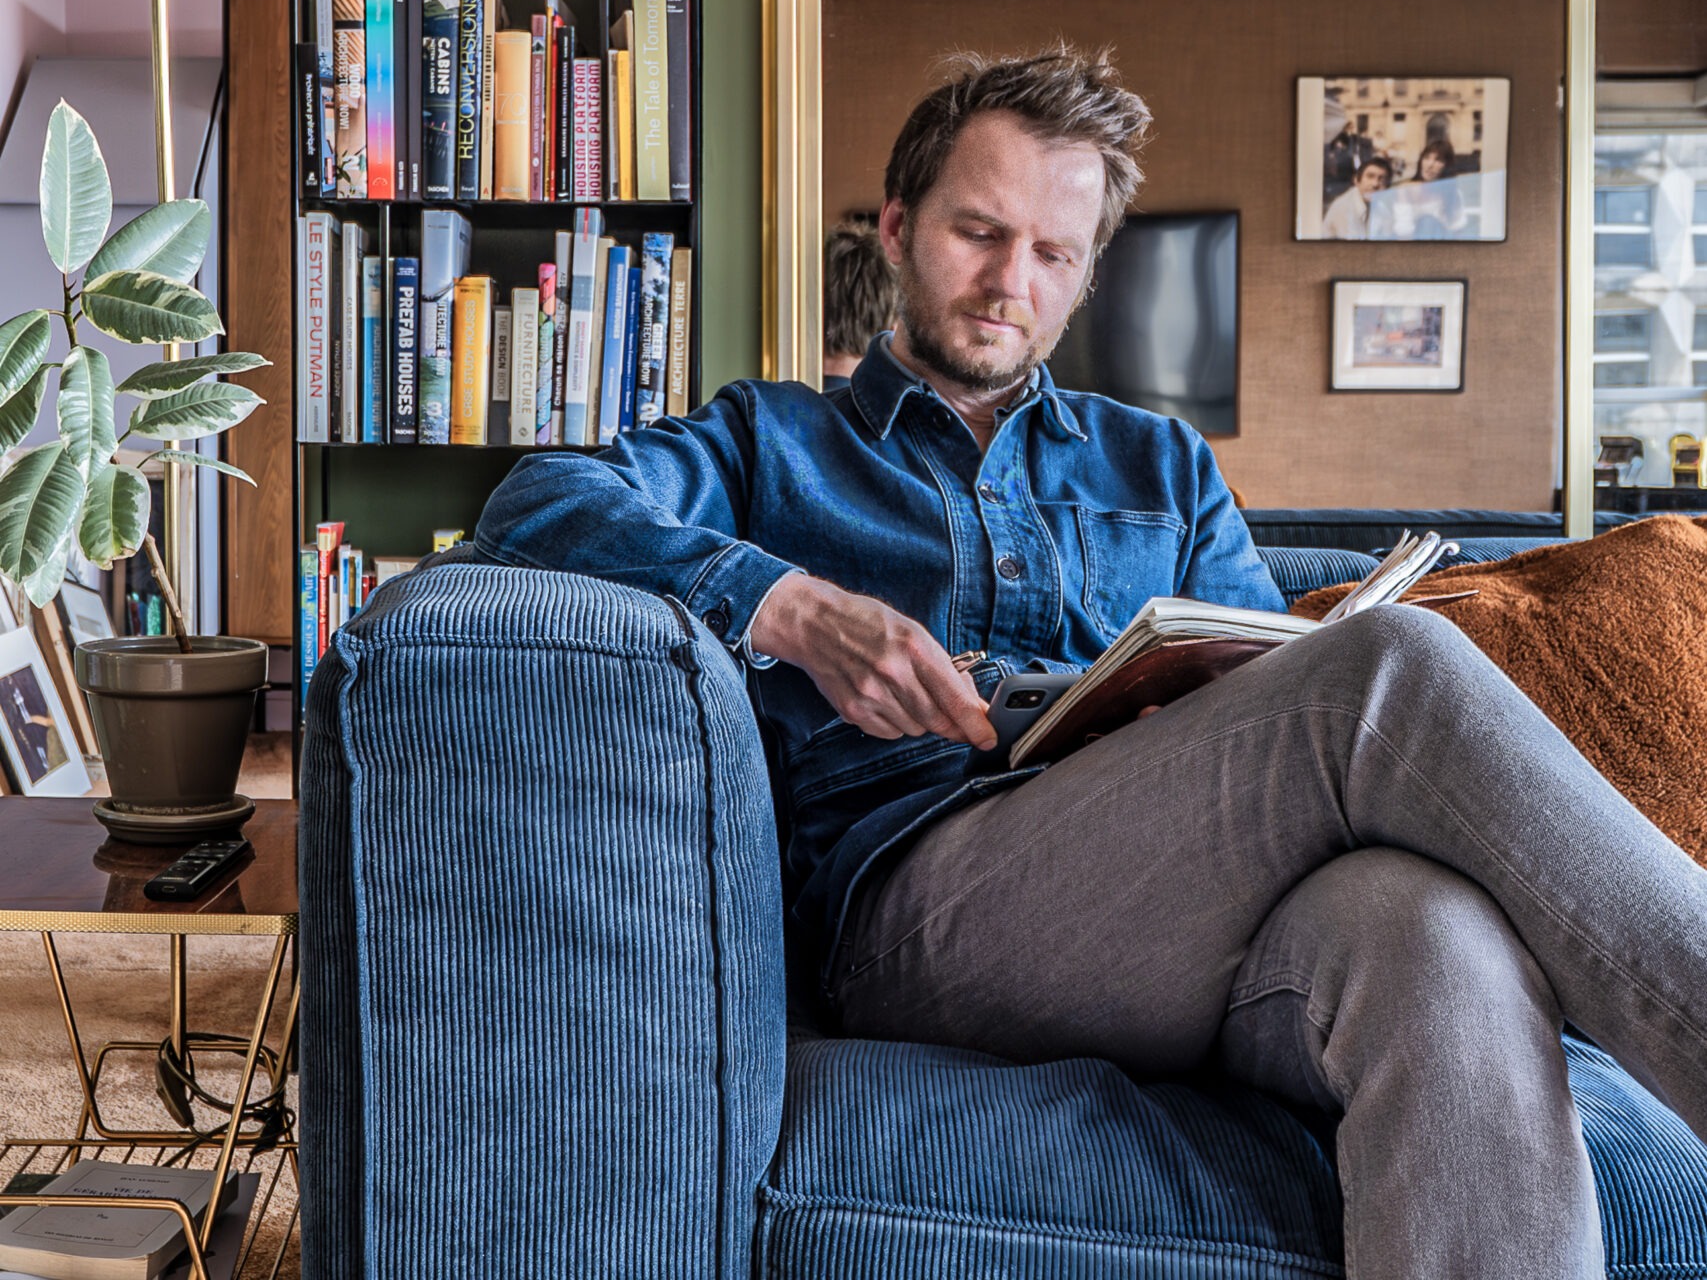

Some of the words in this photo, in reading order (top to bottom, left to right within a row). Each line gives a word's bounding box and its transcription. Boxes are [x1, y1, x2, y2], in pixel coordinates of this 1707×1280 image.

[337, 32, 348, 100] ARCHITECTURE
[349, 63, 360, 98] WOOD
[436, 37, 451, 94] CABINS
[644, 60, 659, 75] of
[573, 63, 585, 133] PLATFORM
[588, 63, 600, 133] PLATFORM
[644, 79, 659, 113] Tale
[339, 104, 348, 129] NOW!
[644, 118, 660, 149] The
[573, 139, 586, 196] HOUSING
[588, 139, 601, 196] HOUSING
[309, 221, 321, 243] LE
[309, 250, 322, 308] STYLE
[615, 263, 623, 307] INNOVATIVE
[674, 280, 685, 312] TERRE
[399, 286, 413, 348] PREFAB
[464, 299, 475, 345] HOUSES
[613, 308, 621, 339] HOUSES
[641, 296, 653, 358] ARCHITECTURE
[309, 315, 322, 397] PUTMAN
[333, 340, 341, 368] PUTMAN
[497, 335, 506, 369] DESIGN
[555, 334, 563, 363] maison
[651, 323, 663, 359] GREEN
[670, 316, 685, 394] ARCHITECTURE
[464, 347, 474, 384] STUDY
[519, 313, 536, 414] FURNITECTURE
[556, 364, 563, 374] sa
[641, 361, 650, 384] NOW!
[397, 352, 412, 415] HOUSES
[496, 372, 506, 396] BOOK
[554, 376, 562, 405] Chacun
[426, 402, 441, 416] 3
[463, 387, 473, 417] CASE
[639, 401, 658, 422] 2
[304, 602, 312, 620] DES
[303, 623, 314, 666] DESSOUS
